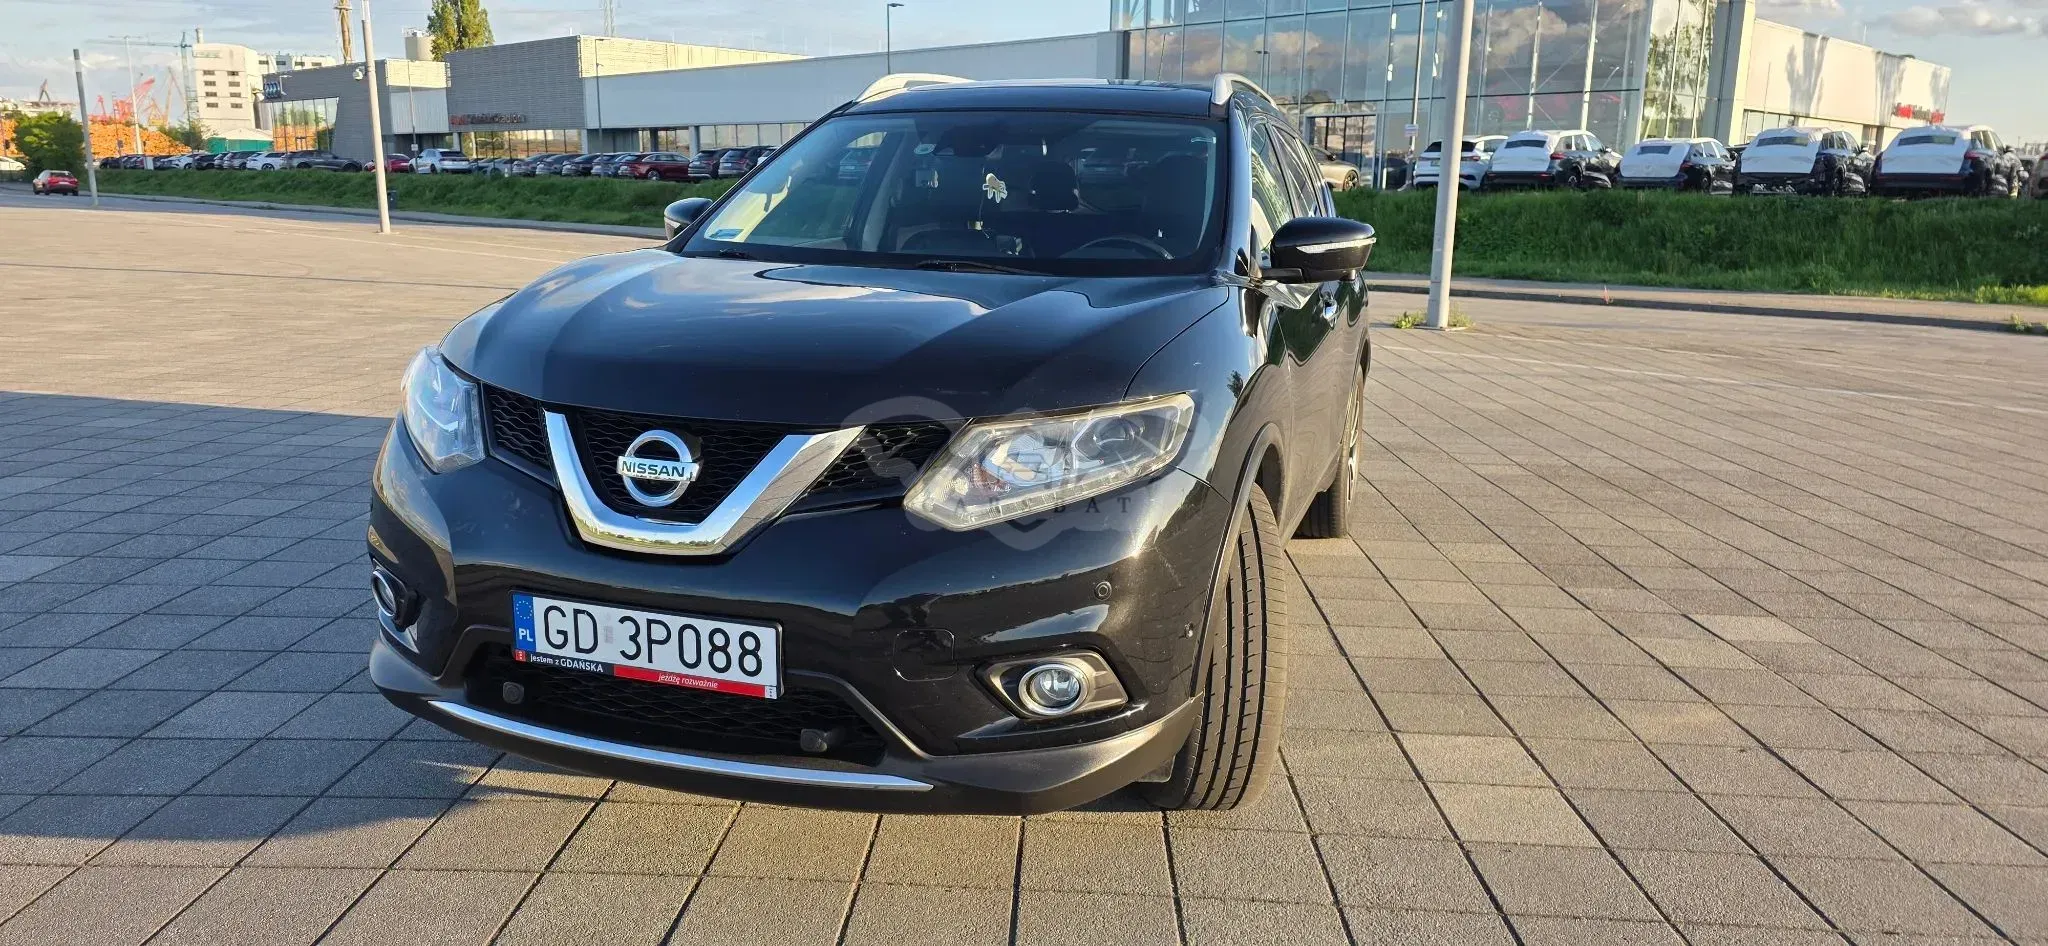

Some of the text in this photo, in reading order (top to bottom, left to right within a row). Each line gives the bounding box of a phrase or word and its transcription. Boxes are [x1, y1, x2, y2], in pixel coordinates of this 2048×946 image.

[621, 460, 685, 477] NISSAN
[518, 628, 534, 642] PL
[543, 604, 763, 677] GD 3P088
[560, 658, 604, 673] GDAŃSKA
